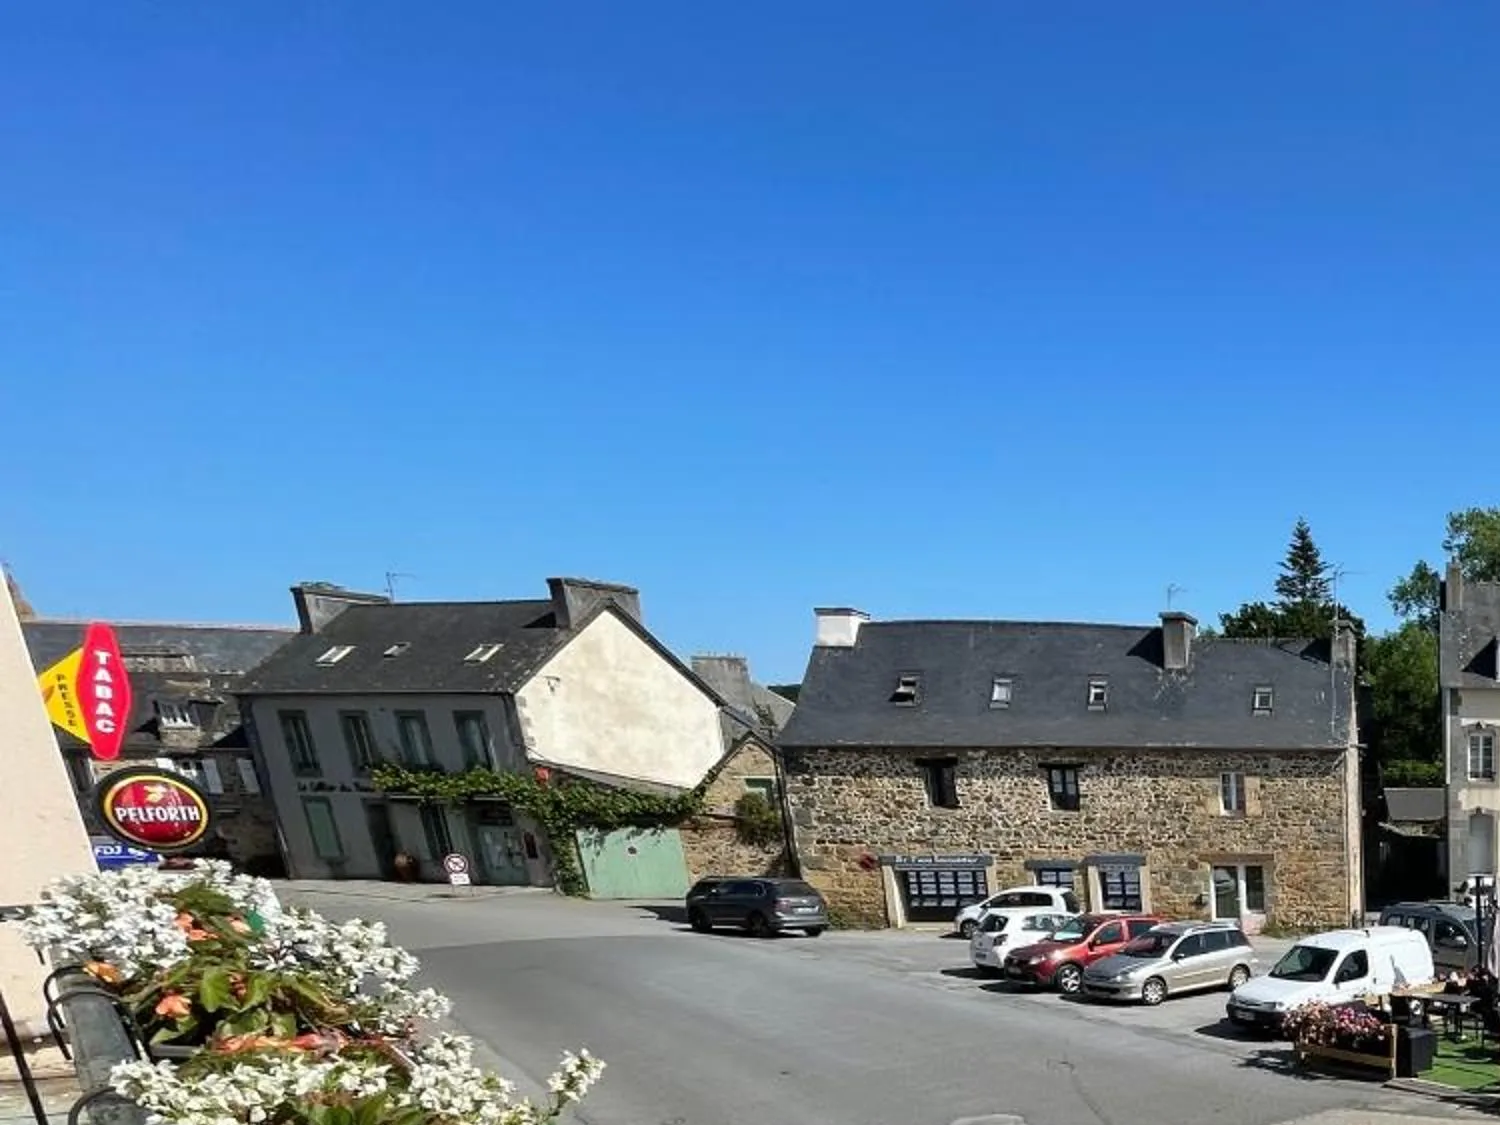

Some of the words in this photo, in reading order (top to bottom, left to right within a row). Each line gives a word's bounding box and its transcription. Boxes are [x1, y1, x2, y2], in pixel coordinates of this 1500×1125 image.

[92, 648, 118, 734] TABAC
[114, 805, 201, 823] PELFORTH
[94, 845, 122, 856] FDJ
